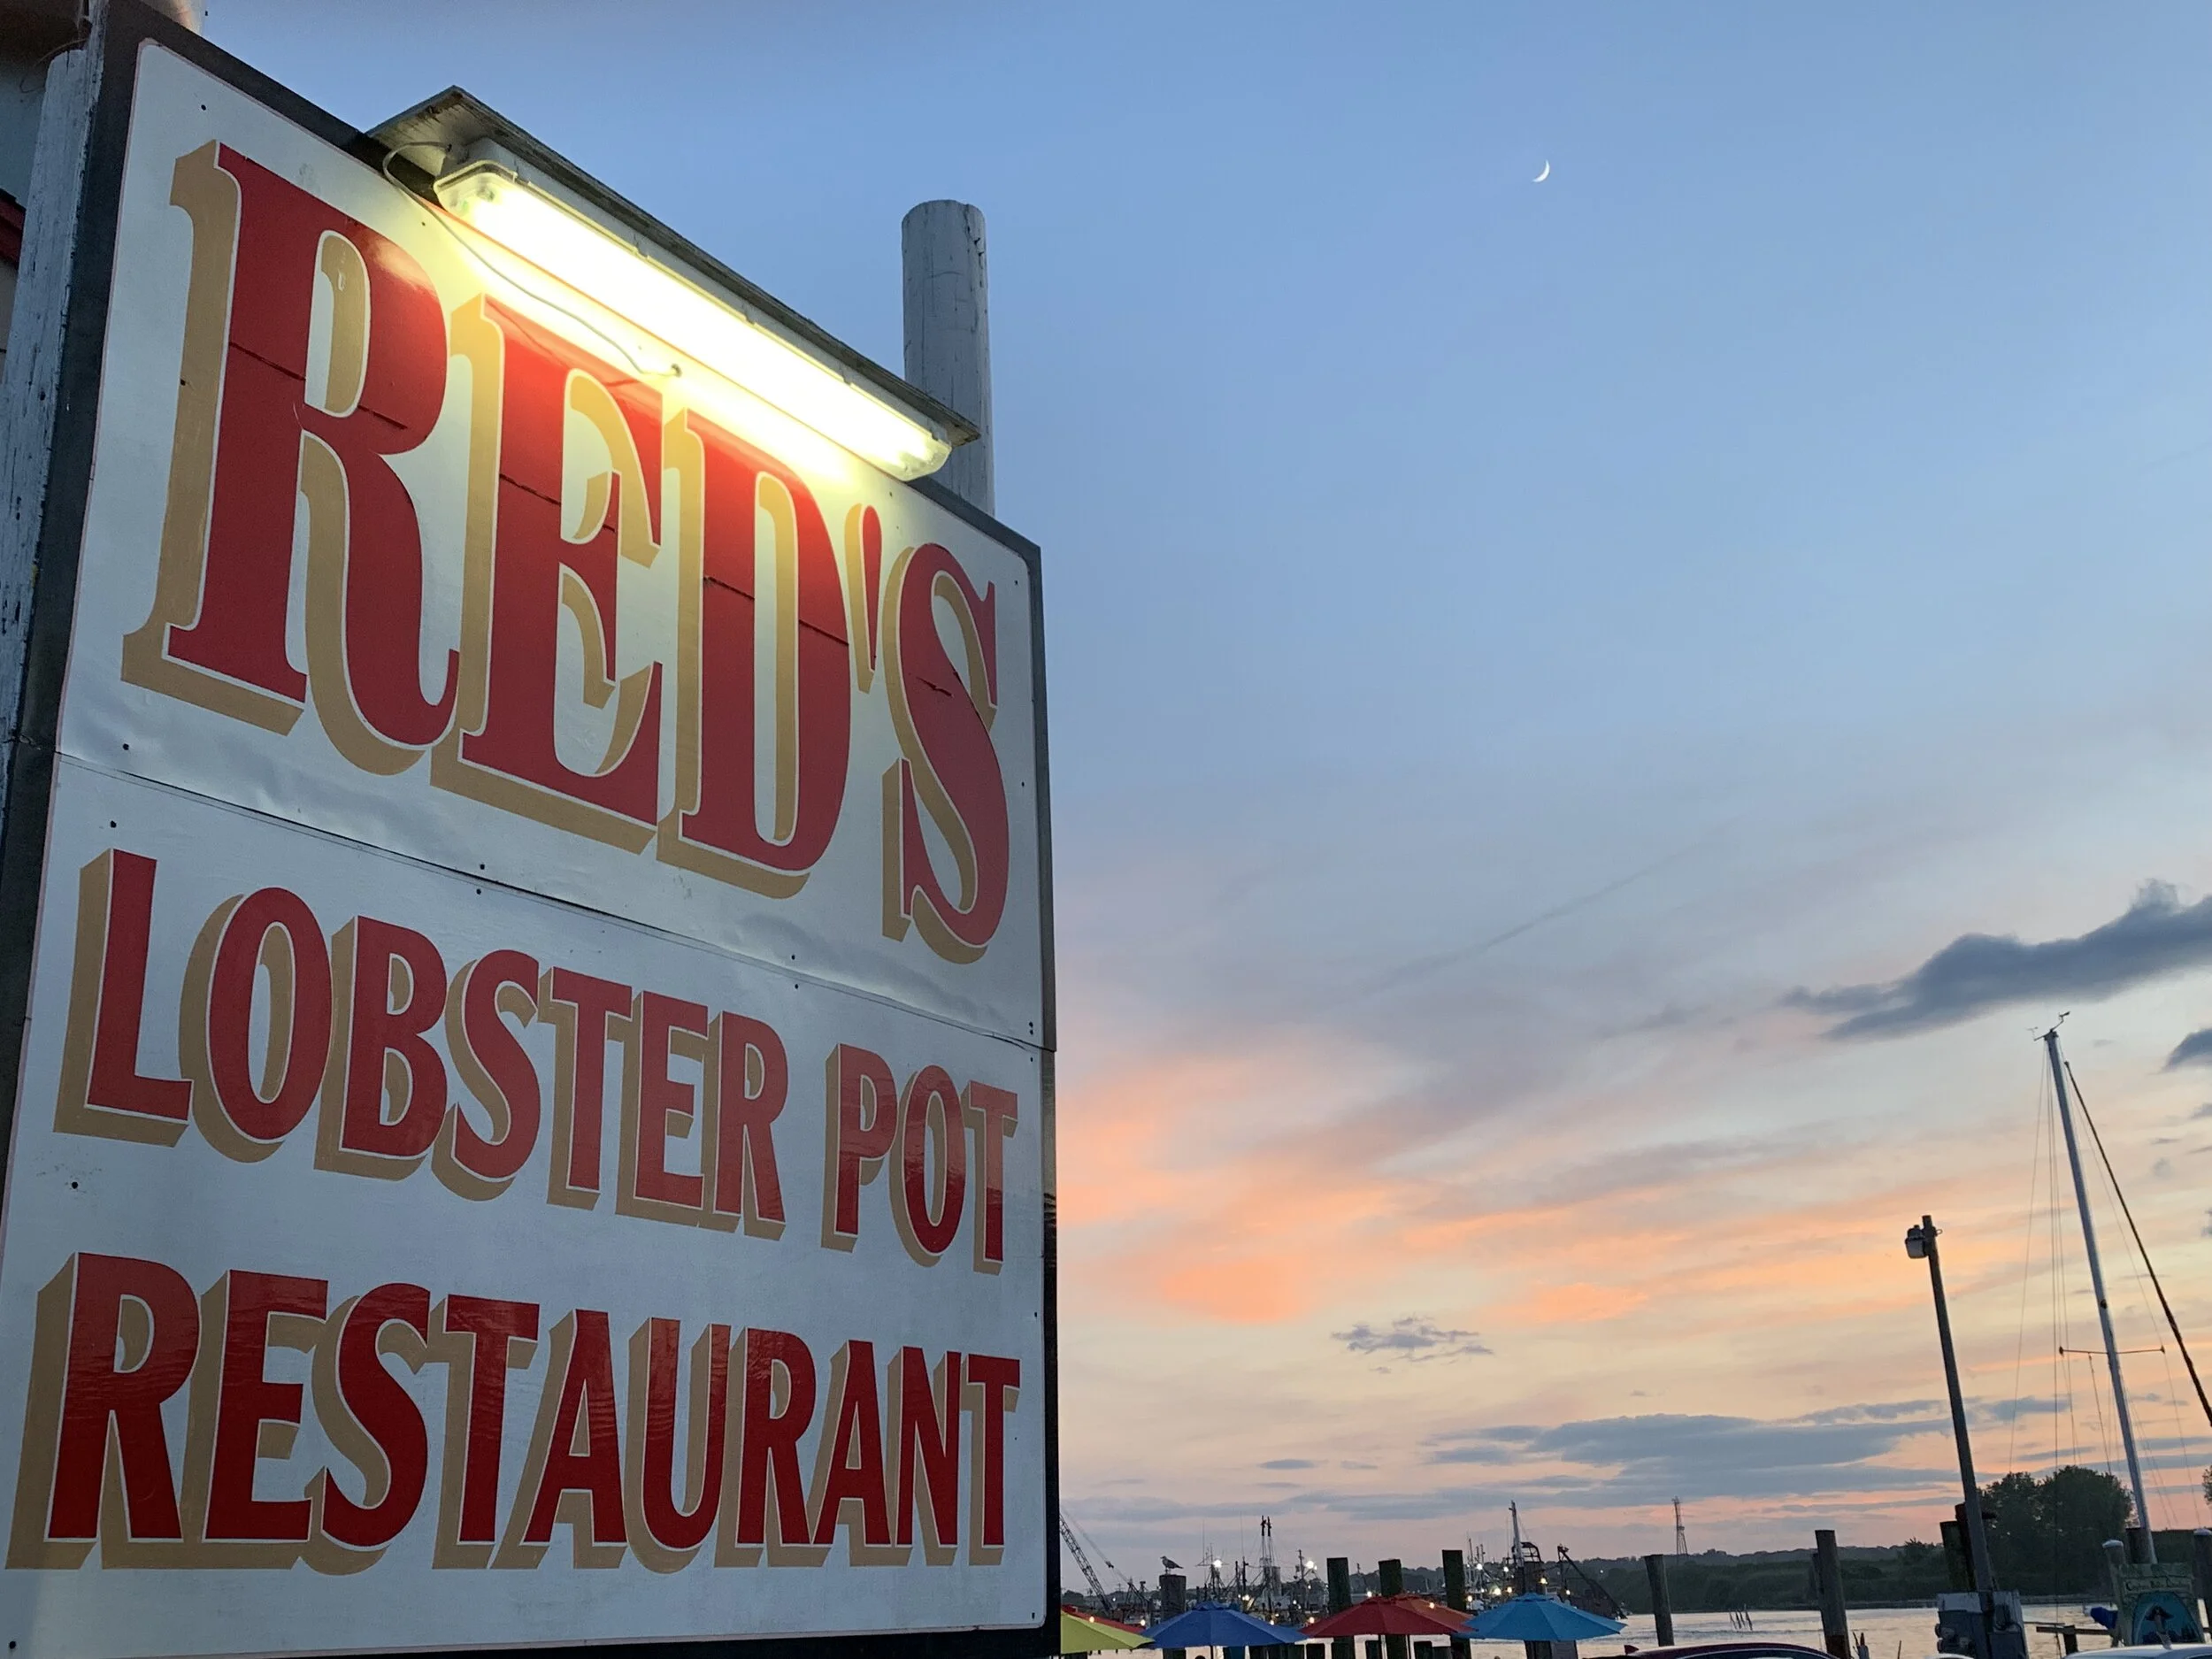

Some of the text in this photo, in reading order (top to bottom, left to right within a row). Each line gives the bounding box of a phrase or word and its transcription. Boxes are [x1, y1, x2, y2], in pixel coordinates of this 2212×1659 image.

[121, 139, 1010, 964] RED'S
[53, 847, 1018, 1275] LOBSTER POT
[5, 1251, 1021, 1576] RESTAURANT
